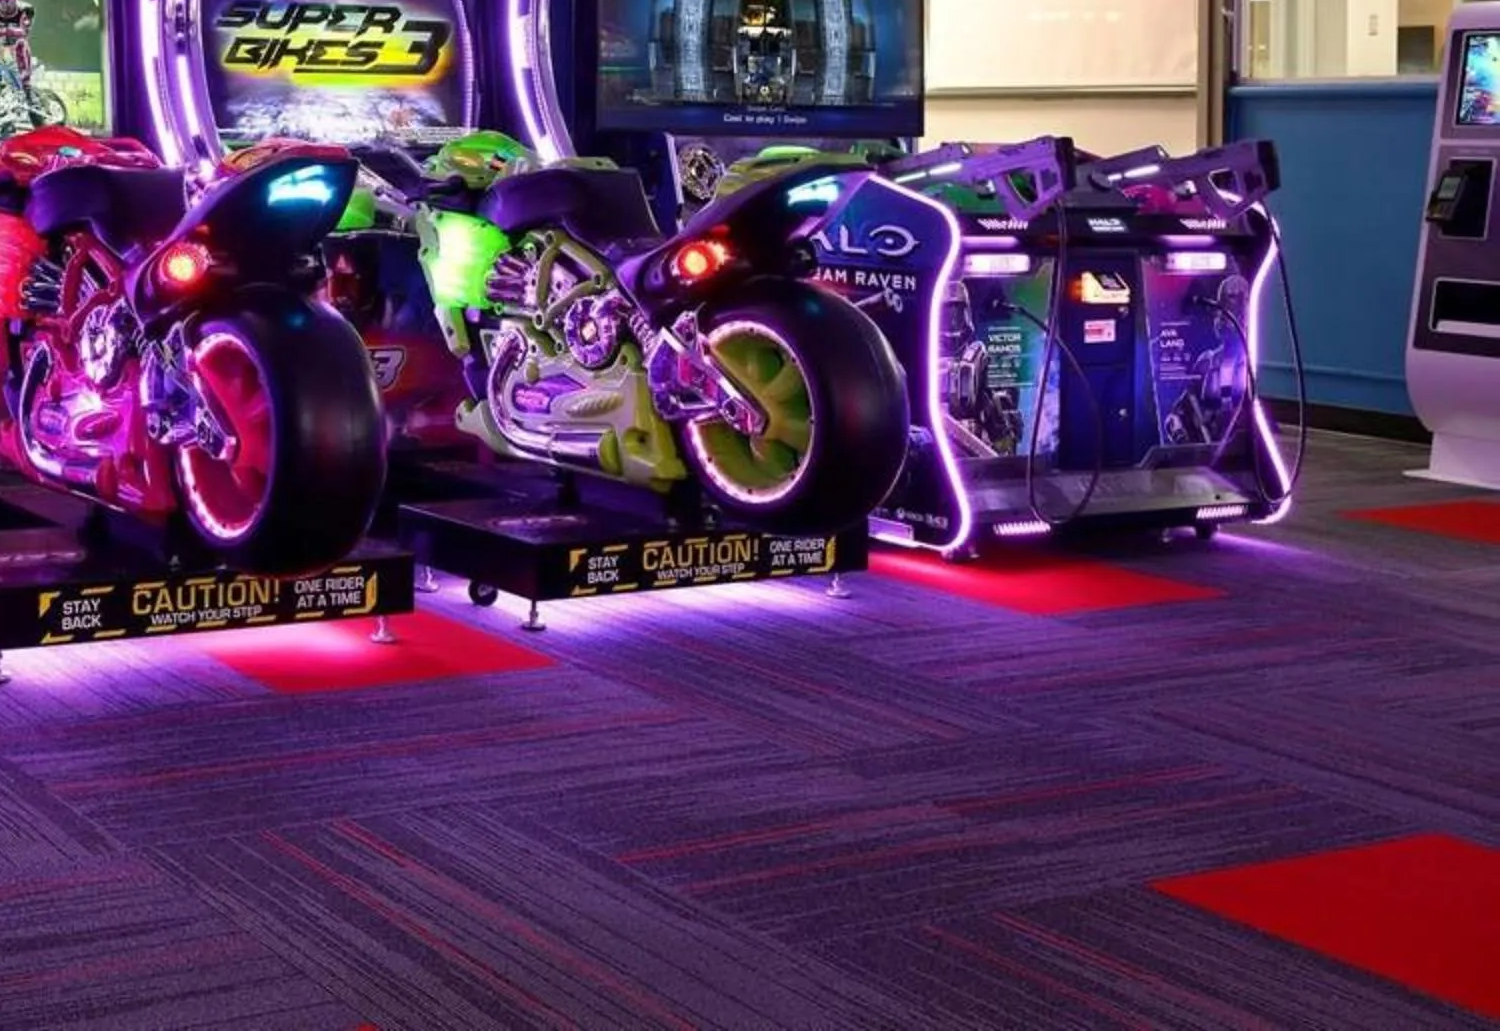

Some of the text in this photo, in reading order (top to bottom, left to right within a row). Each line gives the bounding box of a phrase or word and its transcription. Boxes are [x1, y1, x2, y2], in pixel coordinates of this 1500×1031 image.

[224, 21, 450, 75] BIKES 3
[855, 272, 916, 290] RAVEN
[769, 538, 825, 553] ONE RIDER
[587, 556, 619, 570] STAY
[642, 539, 759, 571] CAUTION!
[771, 551, 823, 566] AT A TIME
[587, 569, 619, 584] BACK
[657, 563, 745, 580] WATCH YOUR STEP
[294, 577, 364, 595] ONE RIDER
[132, 580, 280, 616] CAUTION!
[297, 591, 360, 609] AT A TIME
[62, 599, 101, 615] STAY
[151, 604, 262, 625] WATCH YOUR STEP
[61, 614, 101, 631] BACK
